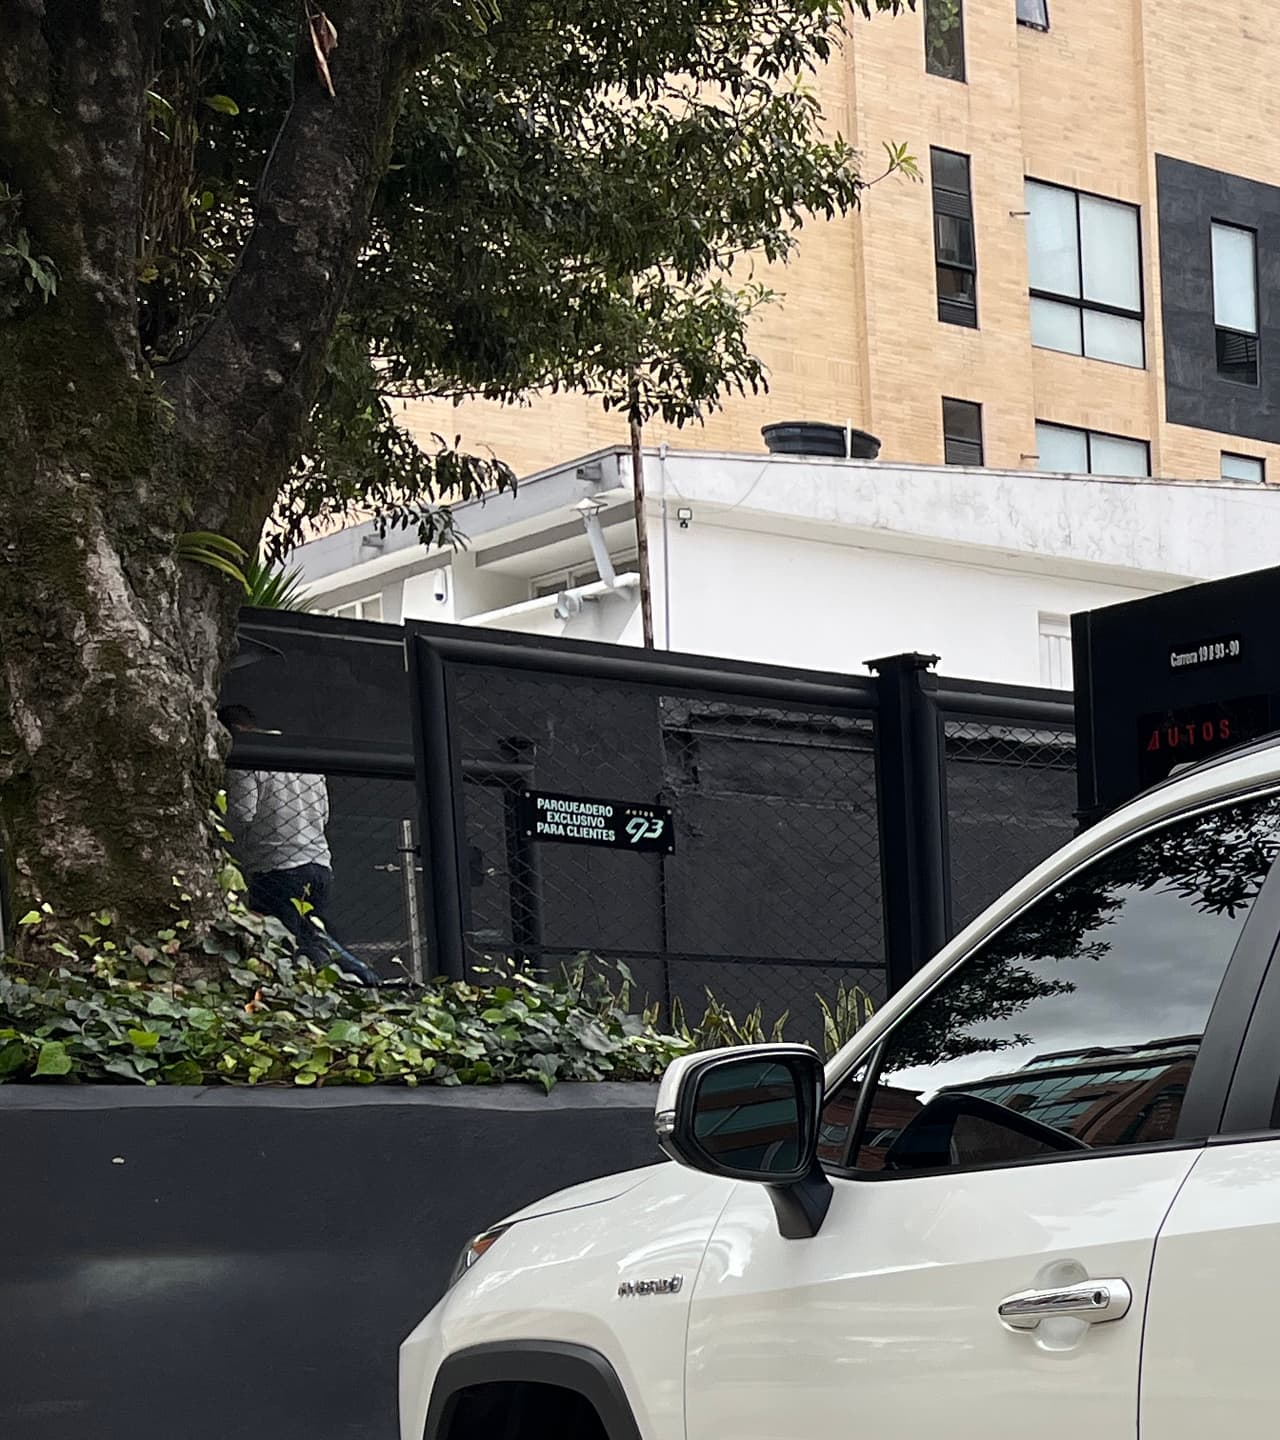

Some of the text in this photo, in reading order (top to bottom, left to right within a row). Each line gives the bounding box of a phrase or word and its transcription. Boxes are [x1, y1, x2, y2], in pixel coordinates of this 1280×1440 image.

[1147, 719, 1230, 751] AUTOS
[537, 798, 613, 817] PARQUEADERO
[547, 811, 605, 828] EXCLUSIVO
[537, 822, 616, 841] PARA CLIENTES
[625, 817, 664, 844] 93
